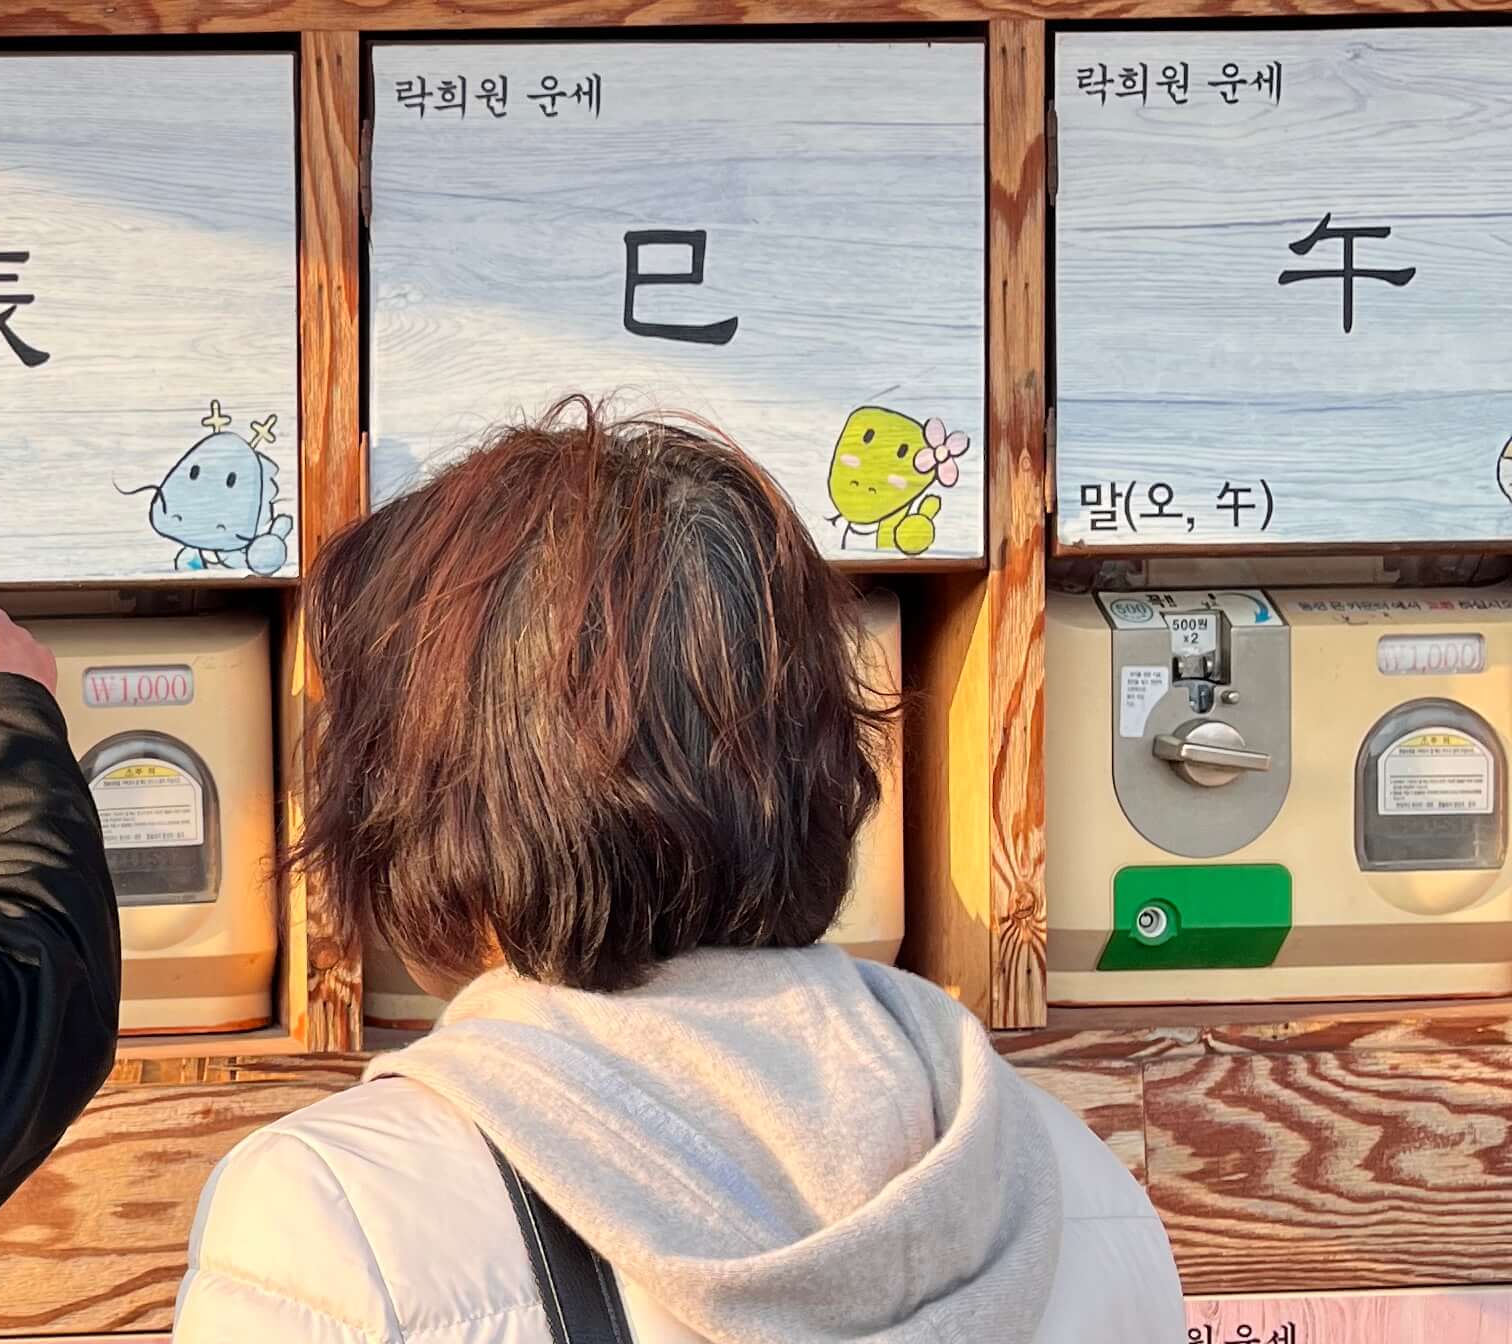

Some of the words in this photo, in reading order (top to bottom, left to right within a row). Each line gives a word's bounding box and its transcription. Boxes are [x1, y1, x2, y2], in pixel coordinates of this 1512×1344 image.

[395, 73, 509, 119] 락희원
[526, 73, 602, 118] 운세
[1076, 62, 1190, 106] 락희원
[1207, 61, 1284, 105] 운세
[1278, 212, 1416, 333] 午
[1079, 481, 1197, 533] 말(오,
[1216, 479, 1275, 531] 午)
